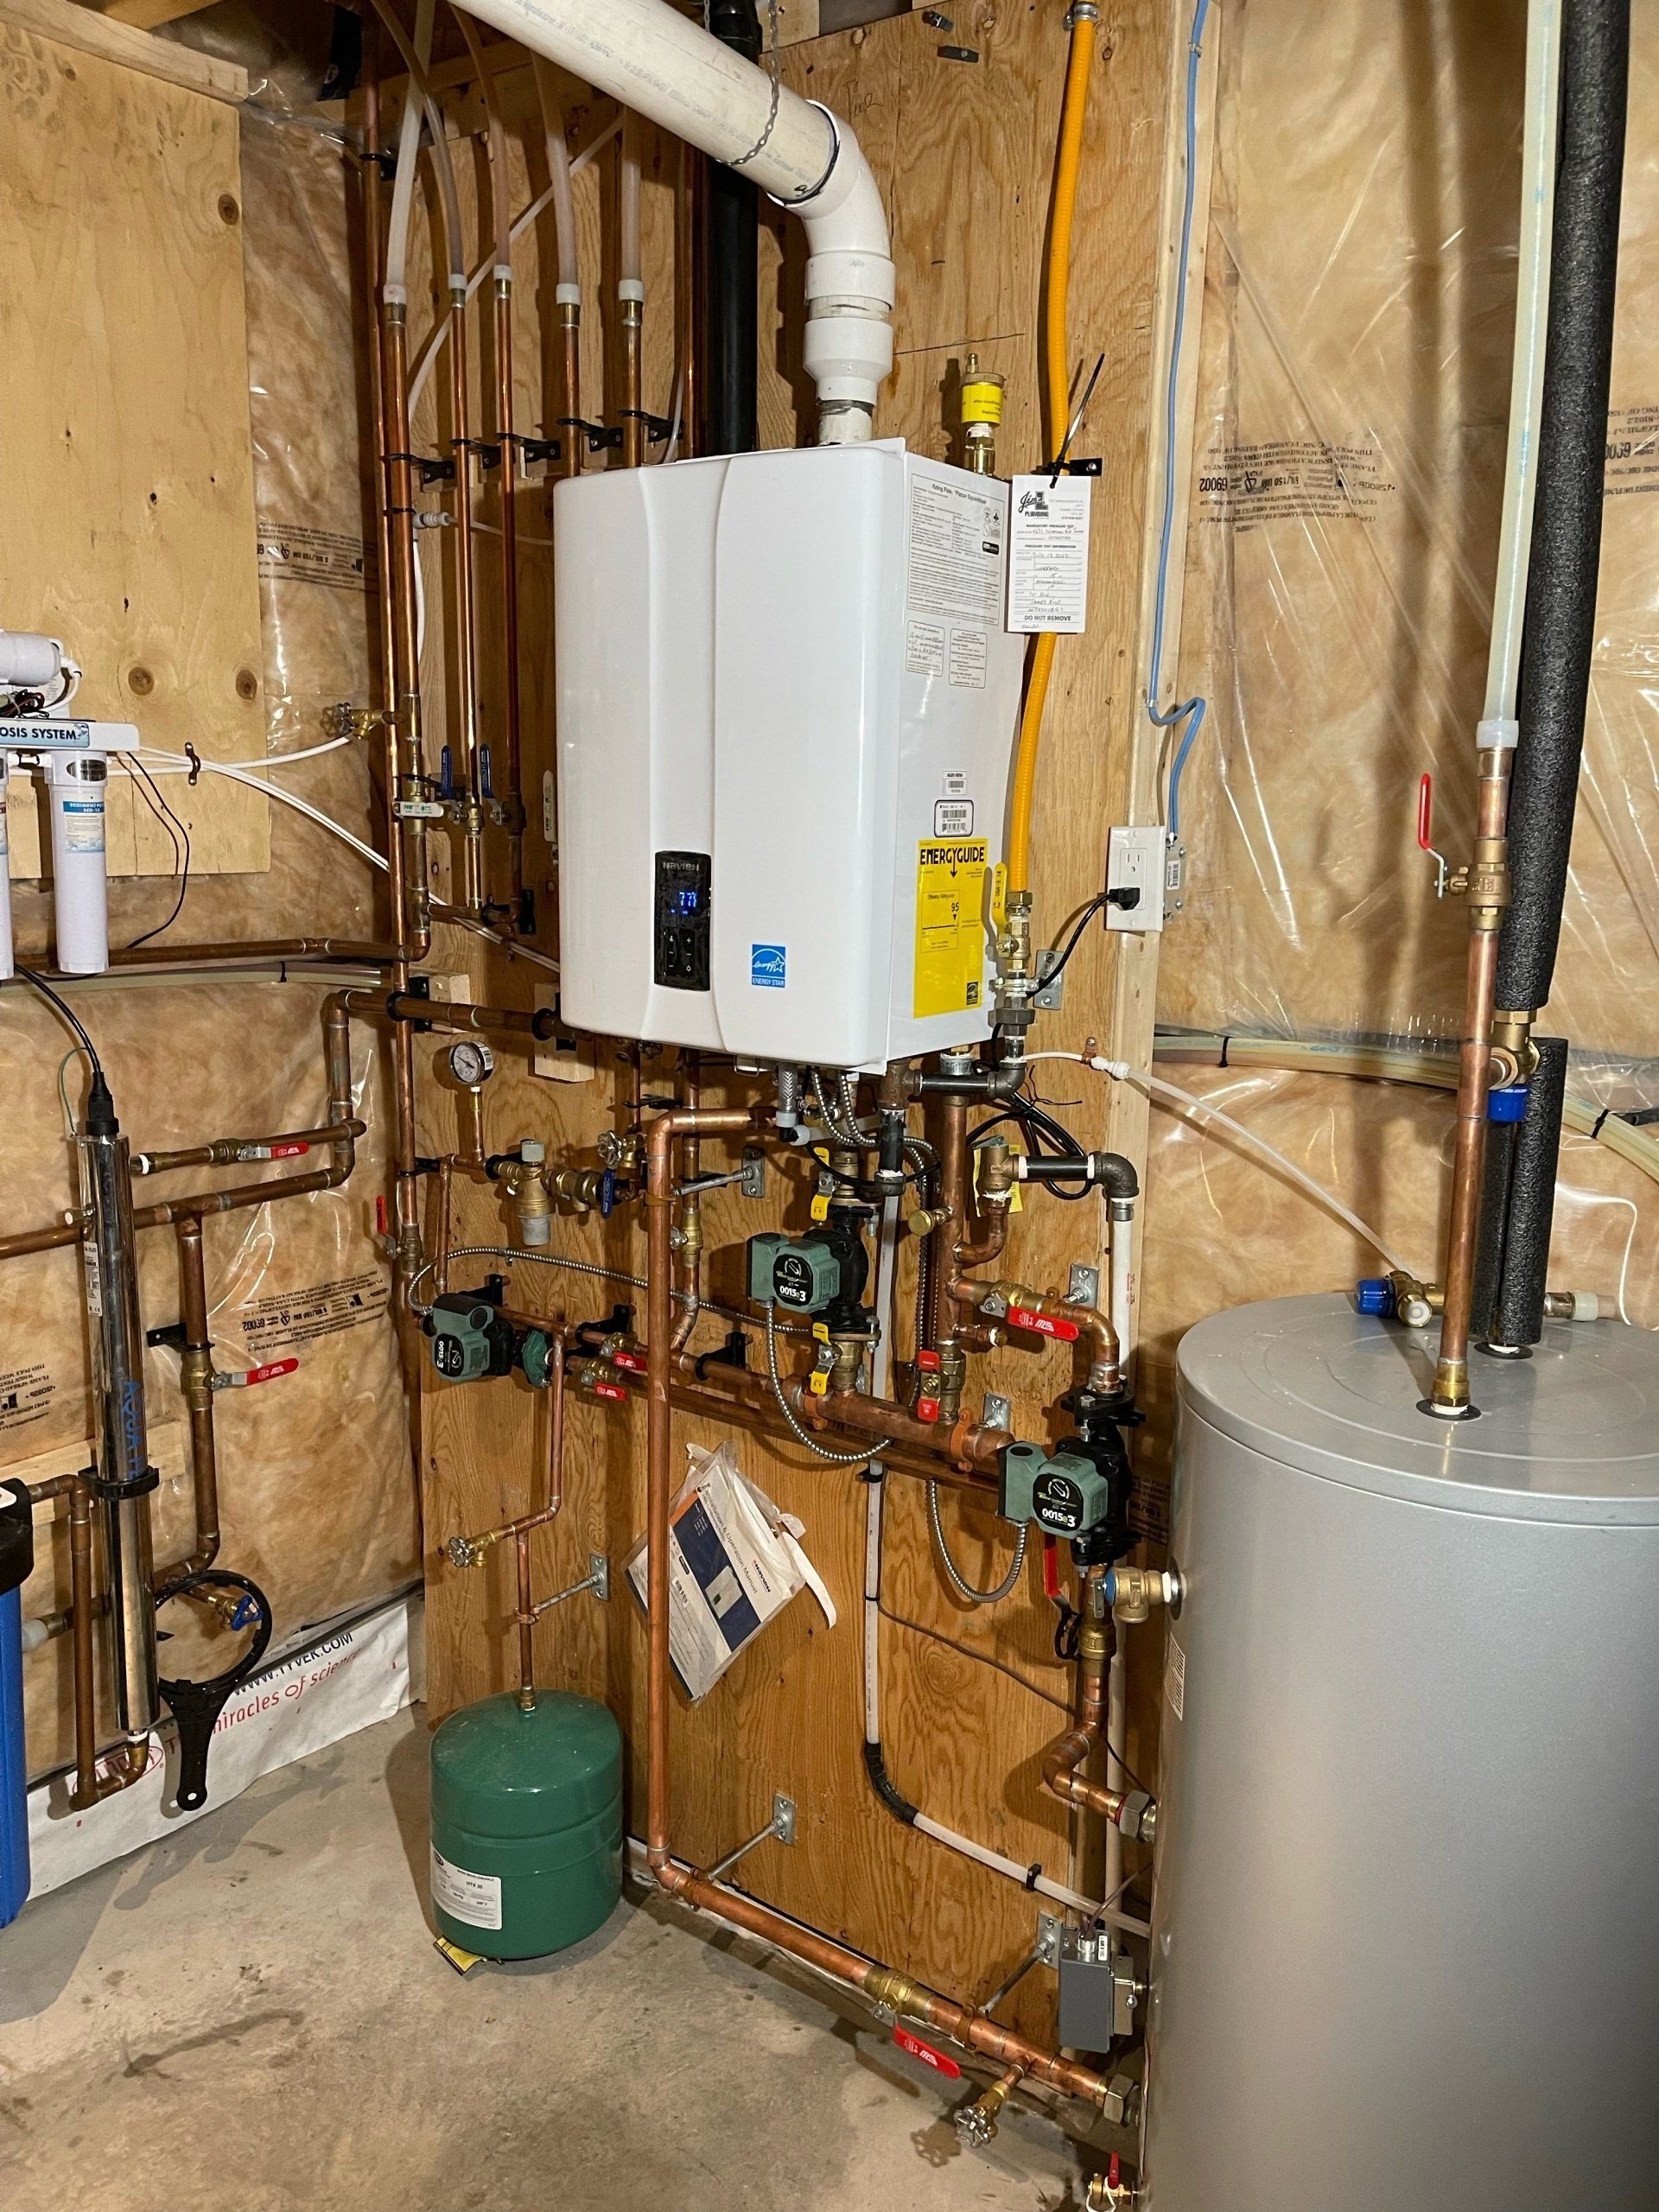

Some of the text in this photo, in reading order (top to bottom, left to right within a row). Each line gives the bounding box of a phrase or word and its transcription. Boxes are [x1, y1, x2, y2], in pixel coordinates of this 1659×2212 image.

[1199, 477, 1228, 493] 69002
[31, 728, 77, 741] SYSTEM
[920, 846, 985, 866] ENERGYGUIDE
[951, 902, 959, 912] 95
[752, 976, 785, 987] ENERGY STAR
[284, 1675, 306, 1700] of
